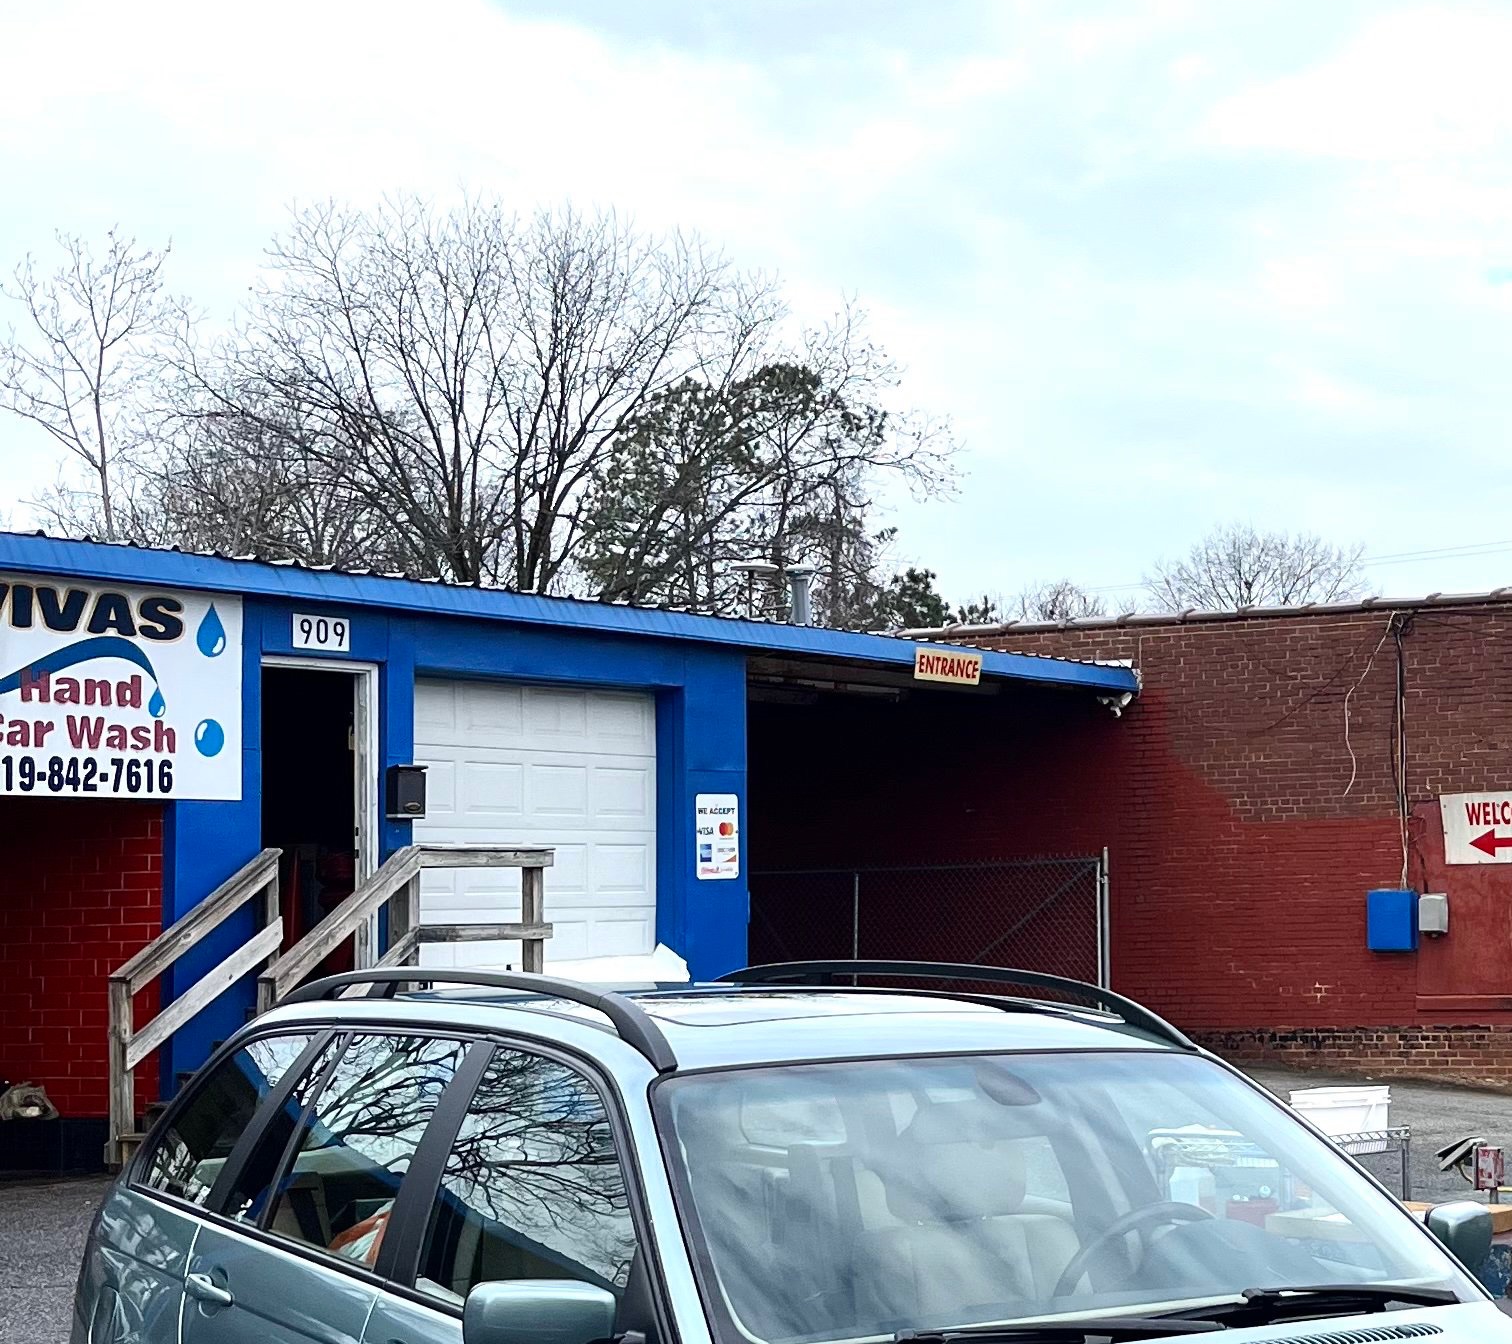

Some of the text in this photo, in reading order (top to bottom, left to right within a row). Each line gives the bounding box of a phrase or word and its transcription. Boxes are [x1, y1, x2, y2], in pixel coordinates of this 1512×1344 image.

[300, 618, 345, 647] 909
[918, 654, 979, 679] ENTRANCE
[20, 668, 142, 708] Hand
[0, 712, 176, 753] ar Wash
[1, 755, 174, 794] 19-842-7616
[709, 807, 736, 815] ACCEPT
